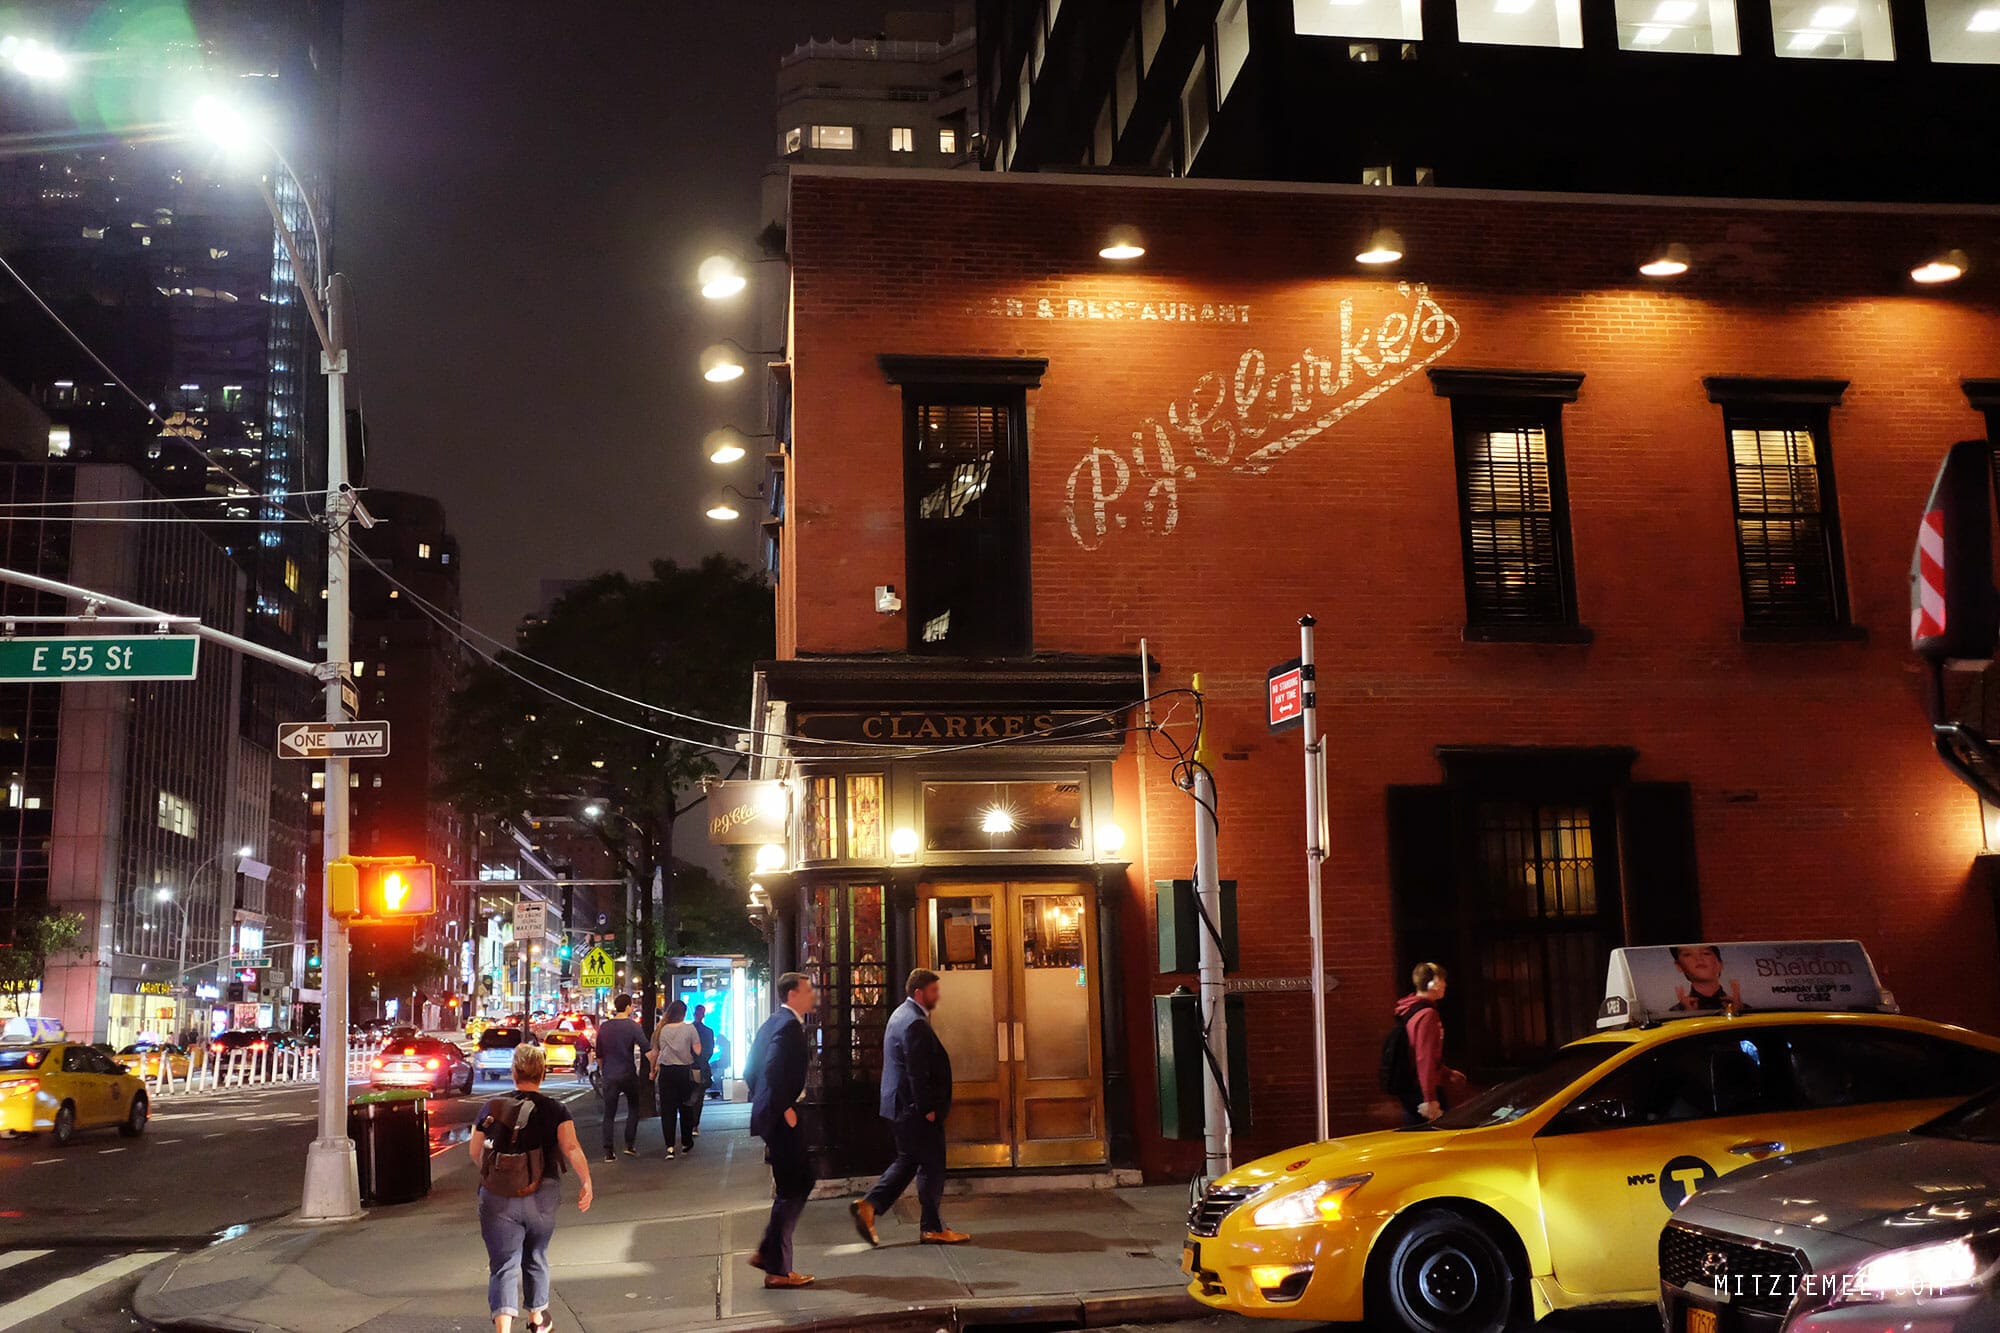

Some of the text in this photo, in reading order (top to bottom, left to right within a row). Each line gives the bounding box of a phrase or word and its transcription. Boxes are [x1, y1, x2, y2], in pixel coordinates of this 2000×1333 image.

[1037, 298, 1055, 318] &
[1067, 299, 1250, 322] RESTAURANT
[1169, 281, 1460, 467] Clarke's
[32, 645, 133, 671] E 55 St
[862, 714, 1053, 738] CLARKE'S
[294, 732, 378, 747] ONE WAY
[1755, 958, 1855, 977] Sheldon
[584, 976, 611, 985] AHEAD
[1771, 985, 1812, 993] MONDAY
[1626, 1173, 1656, 1186] NYC
